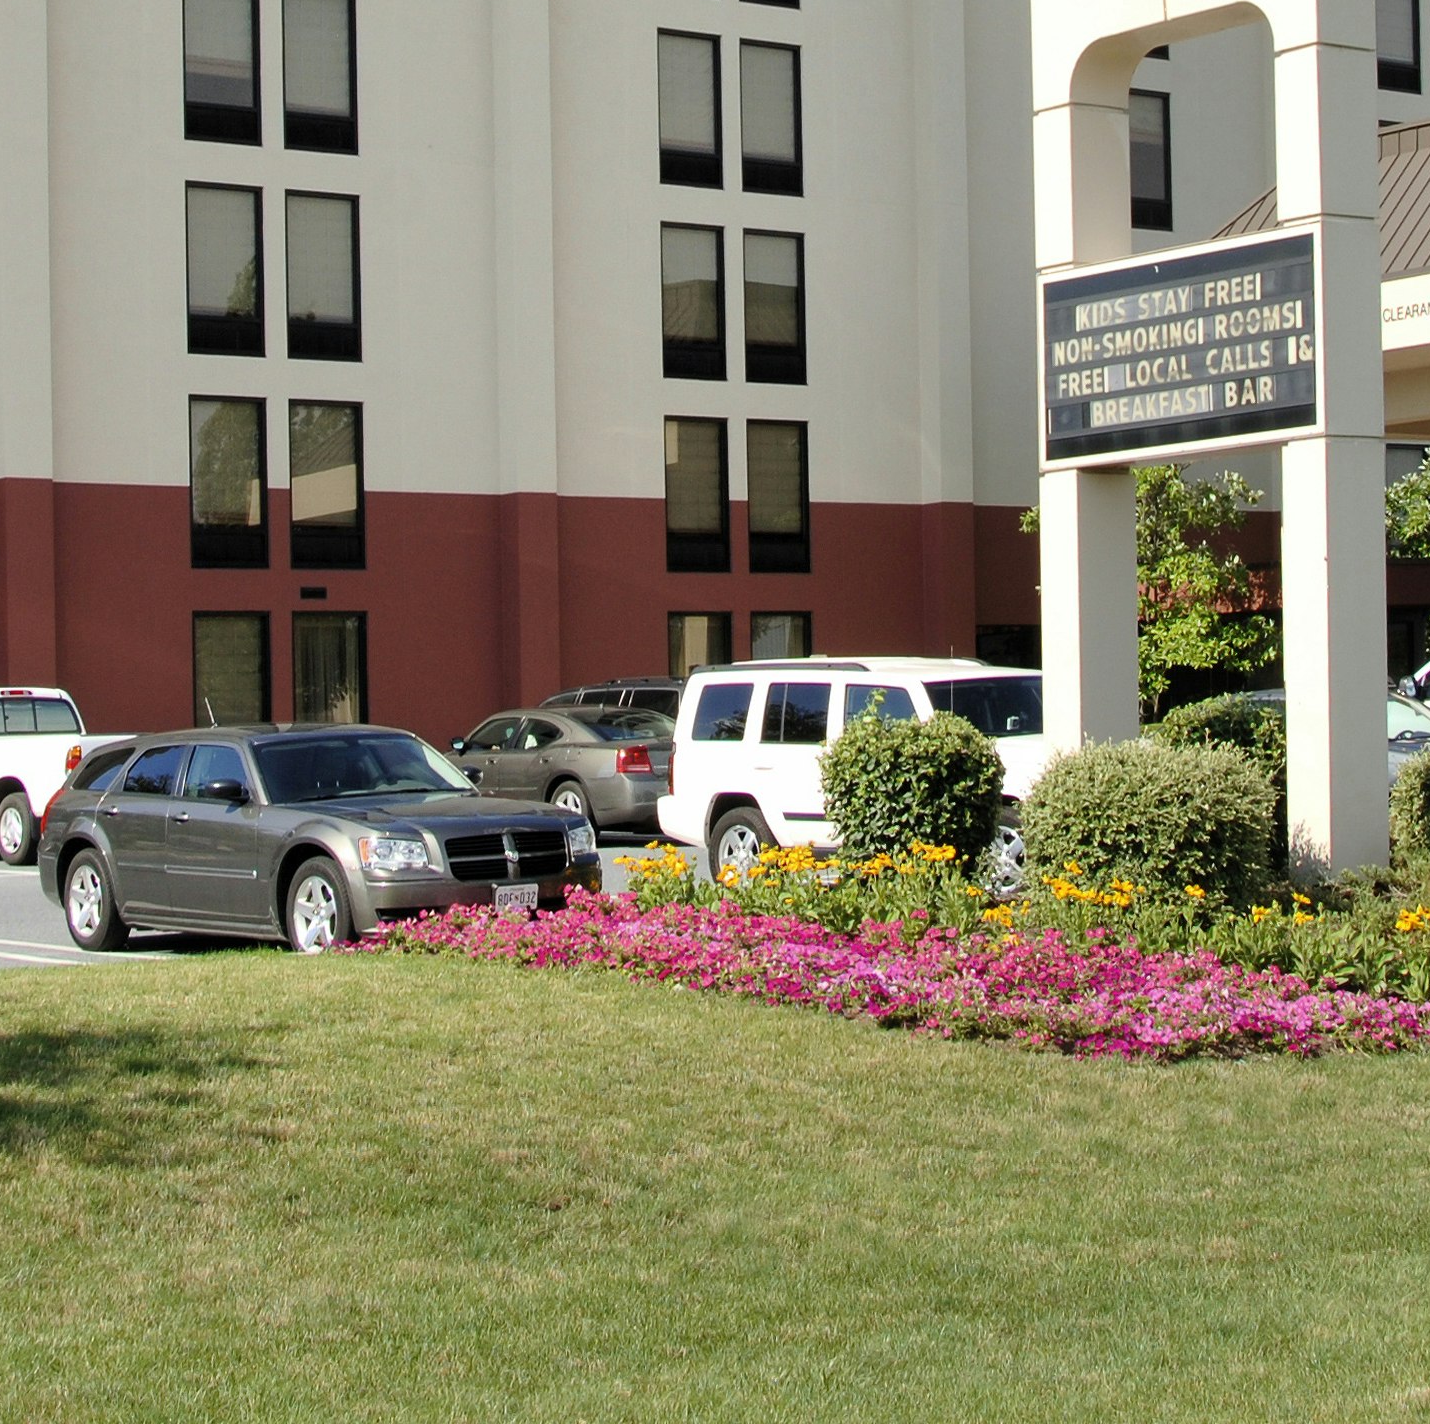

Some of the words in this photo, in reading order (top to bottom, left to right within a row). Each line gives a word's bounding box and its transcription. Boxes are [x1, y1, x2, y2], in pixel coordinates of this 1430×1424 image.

[1079, 297, 1127, 331] KIDS
[1138, 285, 1191, 320] STAY
[1204, 274, 1255, 308] FREE
[1214, 301, 1295, 340] ROOMS
[1059, 367, 1104, 399] FREE
[1125, 354, 1193, 388] LOCAL
[1206, 339, 1272, 375] CALLS
[1092, 384, 1209, 427] BREAKFAST
[1224, 376, 1274, 409] BAR
